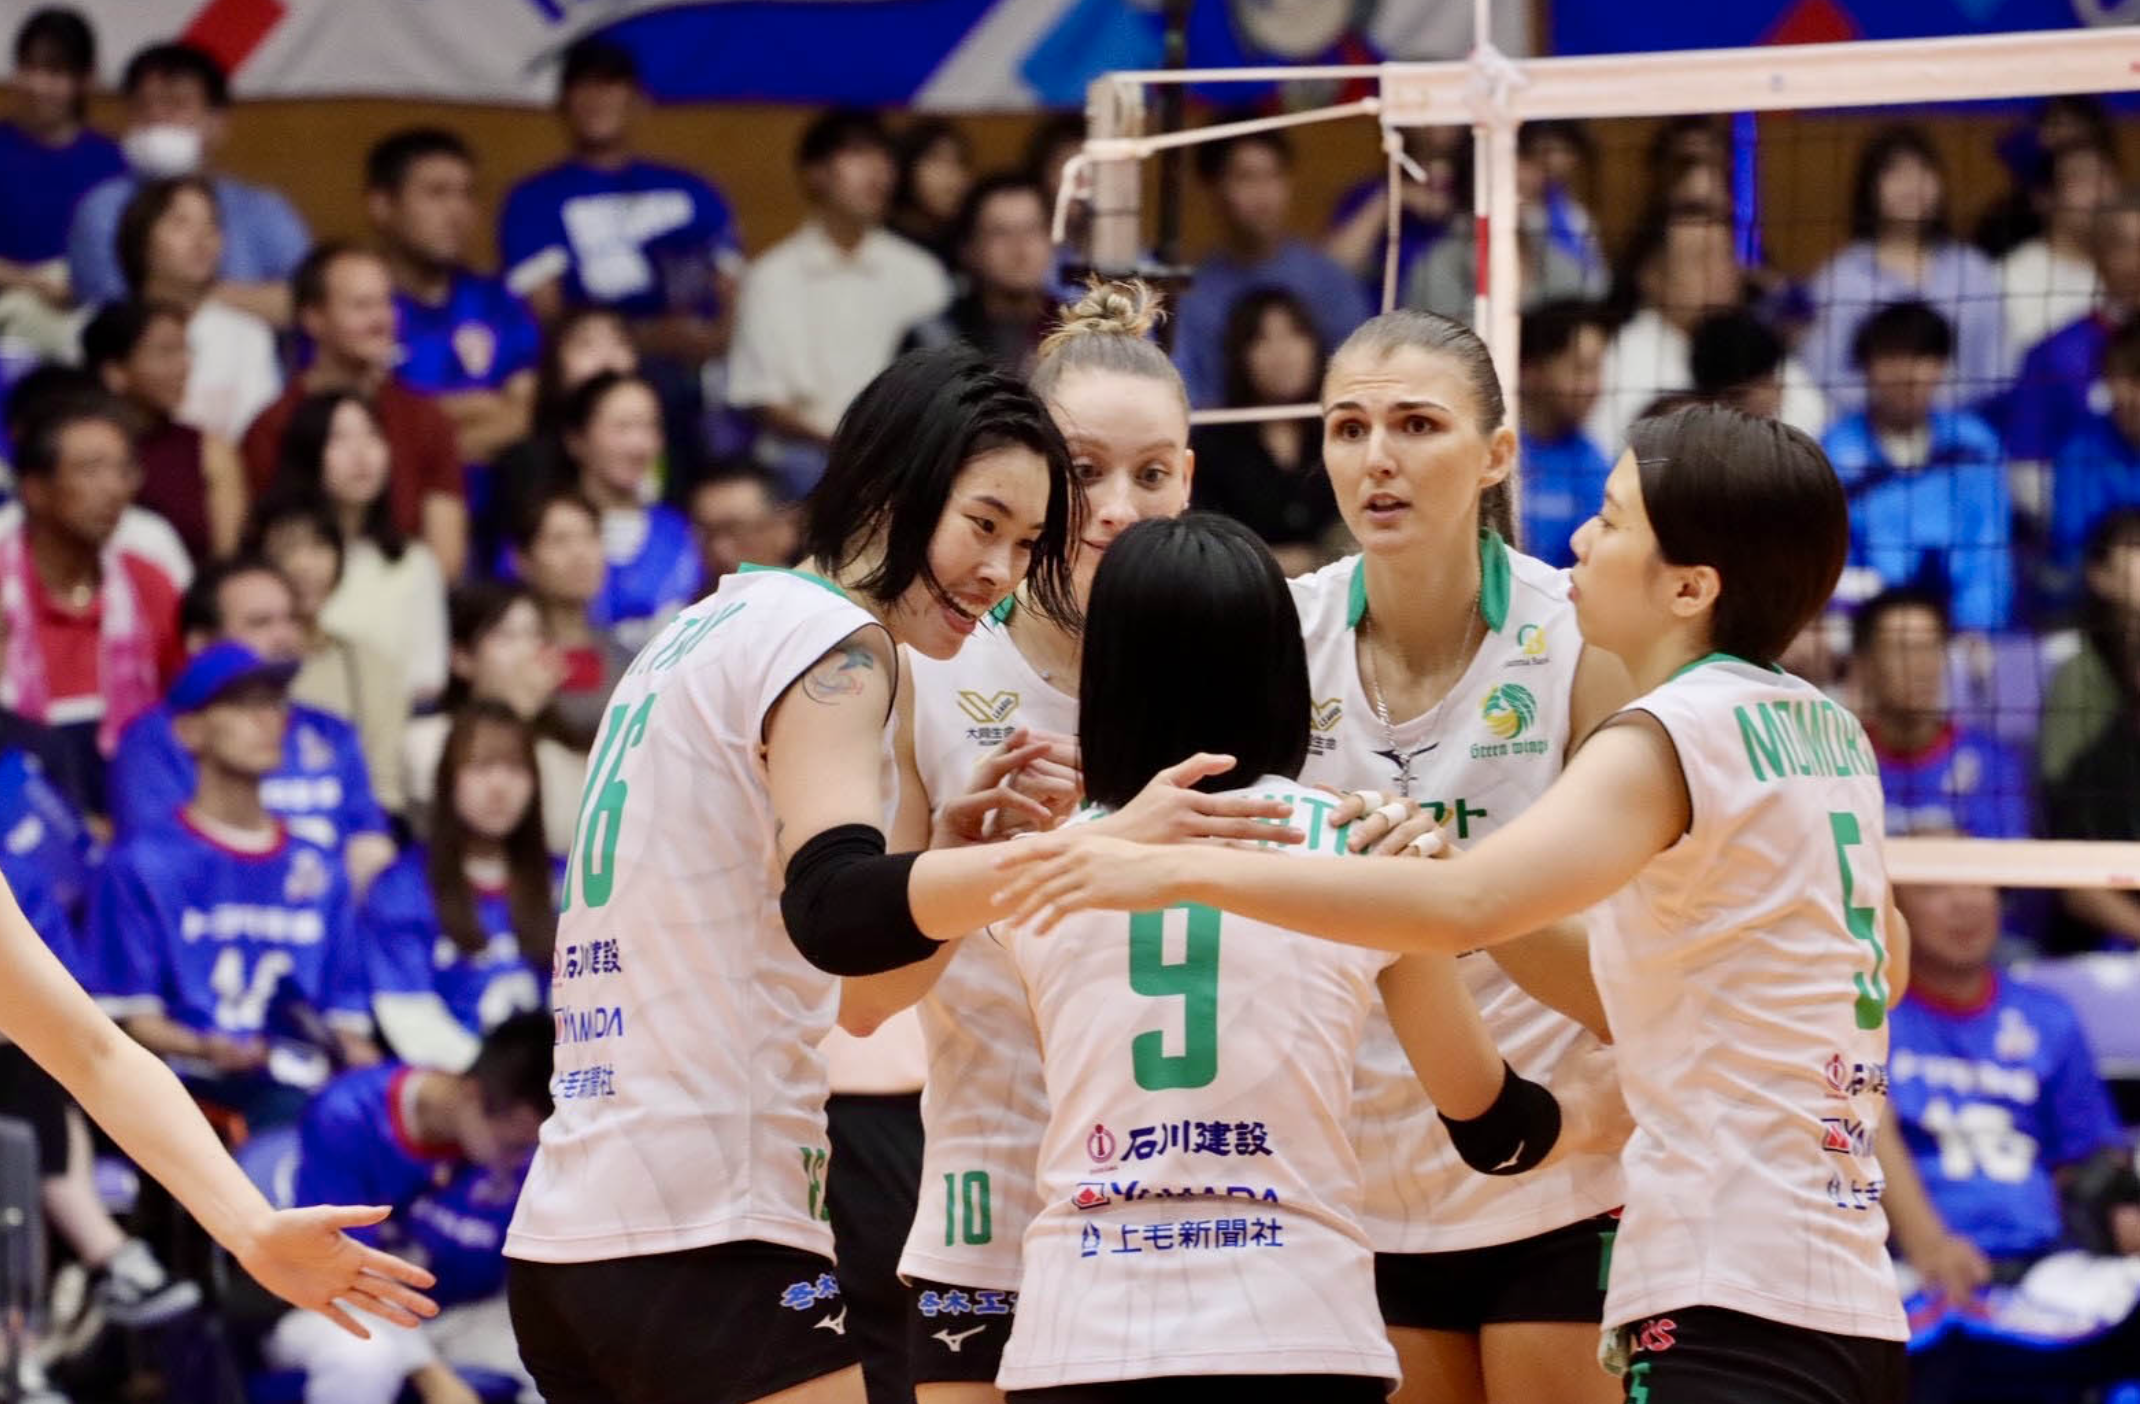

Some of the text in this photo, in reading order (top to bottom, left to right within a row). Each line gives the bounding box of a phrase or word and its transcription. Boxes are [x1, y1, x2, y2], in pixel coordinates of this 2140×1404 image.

[561, 693, 658, 913] 16
[1829, 812, 1886, 1030] 5
[1129, 900, 1222, 1092] 9
[1119, 1120, 1273, 1162] 石川建設
[943, 1170, 992, 1247] 10
[1110, 1217, 1284, 1253] 上毛新聞社
